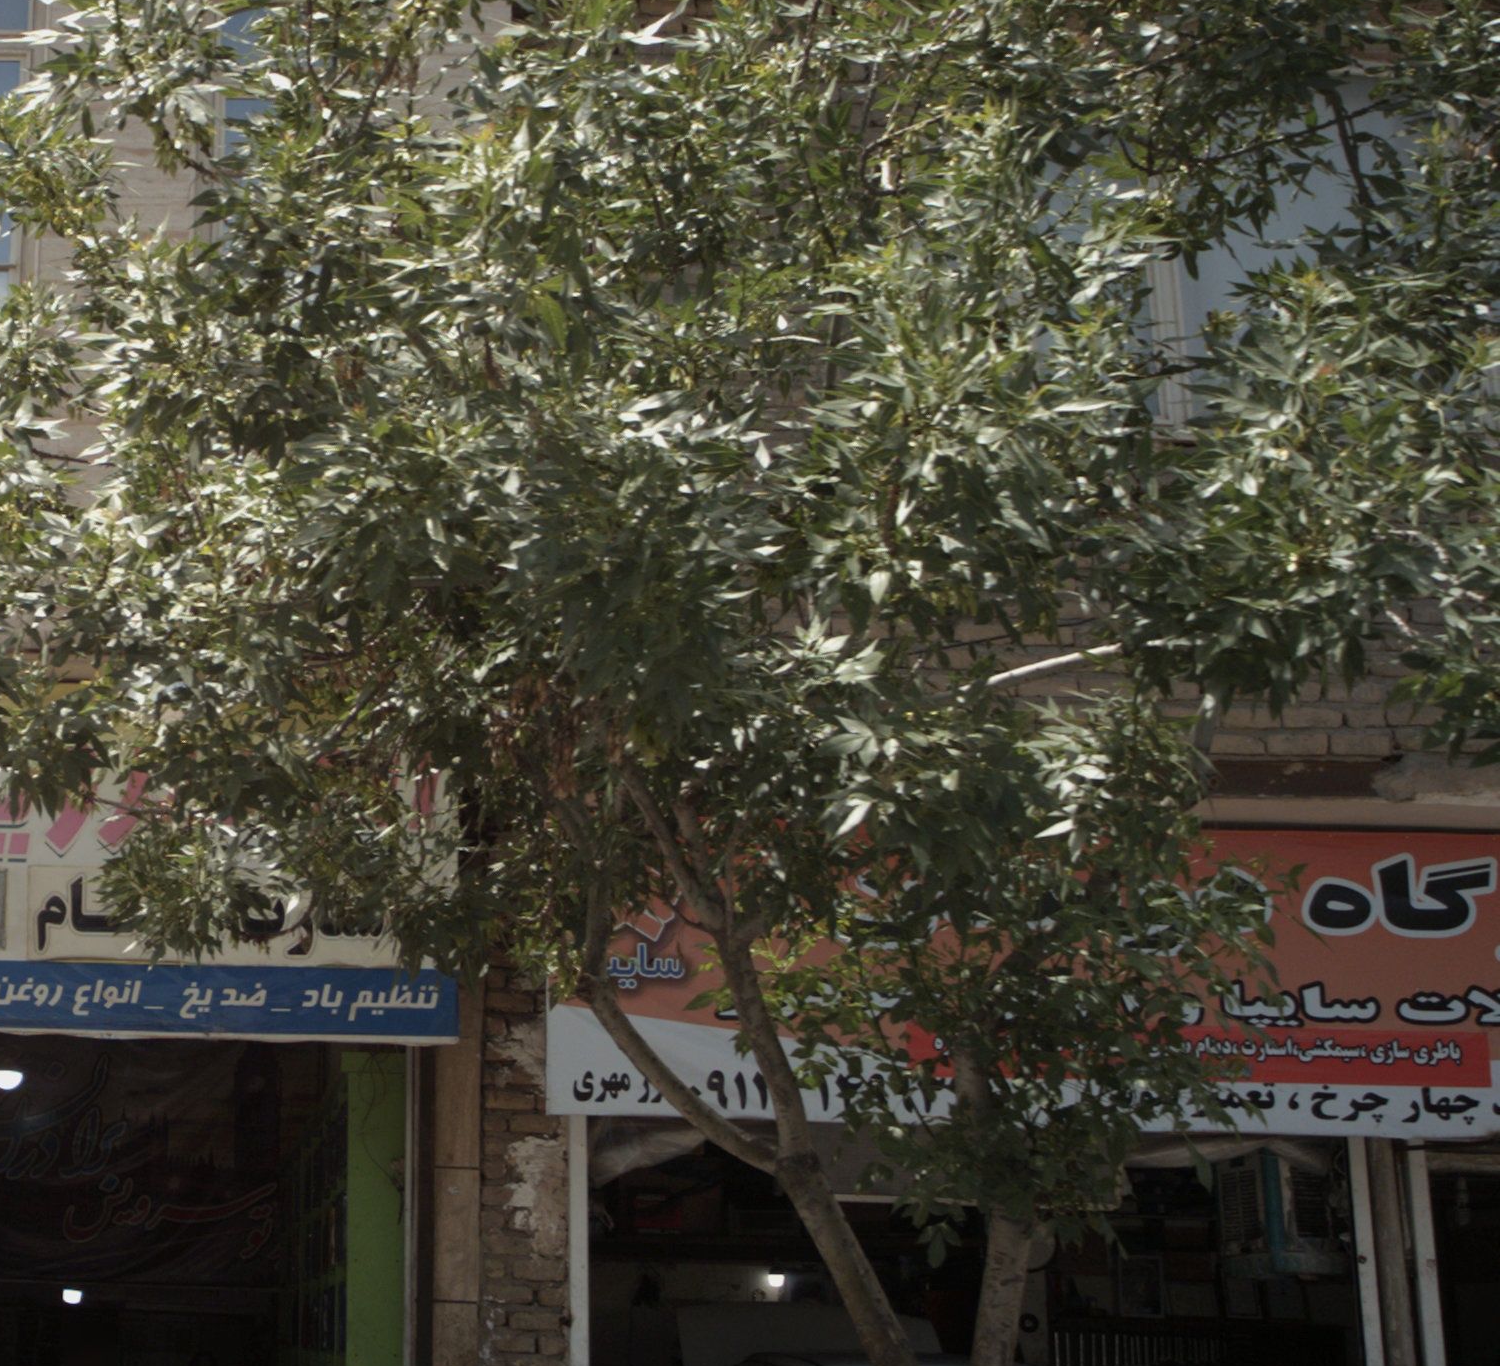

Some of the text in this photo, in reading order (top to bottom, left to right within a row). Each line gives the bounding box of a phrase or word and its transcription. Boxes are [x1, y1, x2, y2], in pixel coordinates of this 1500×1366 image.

[73, 980, 141, 1016] انواع
[179, 986, 213, 1019] یخ
[221, 984, 267, 1005] ضد
[301, 987, 344, 1019] باد
[347, 985, 439, 1022] تنظیم
[1369, 1037, 1411, 1065] سازی
[1413, 1038, 1463, 1067] باطری
[573, 1069, 631, 1103] مهری
[1311, 1086, 1389, 1123] چرخ
[1401, 1087, 1481, 1126] چهار
